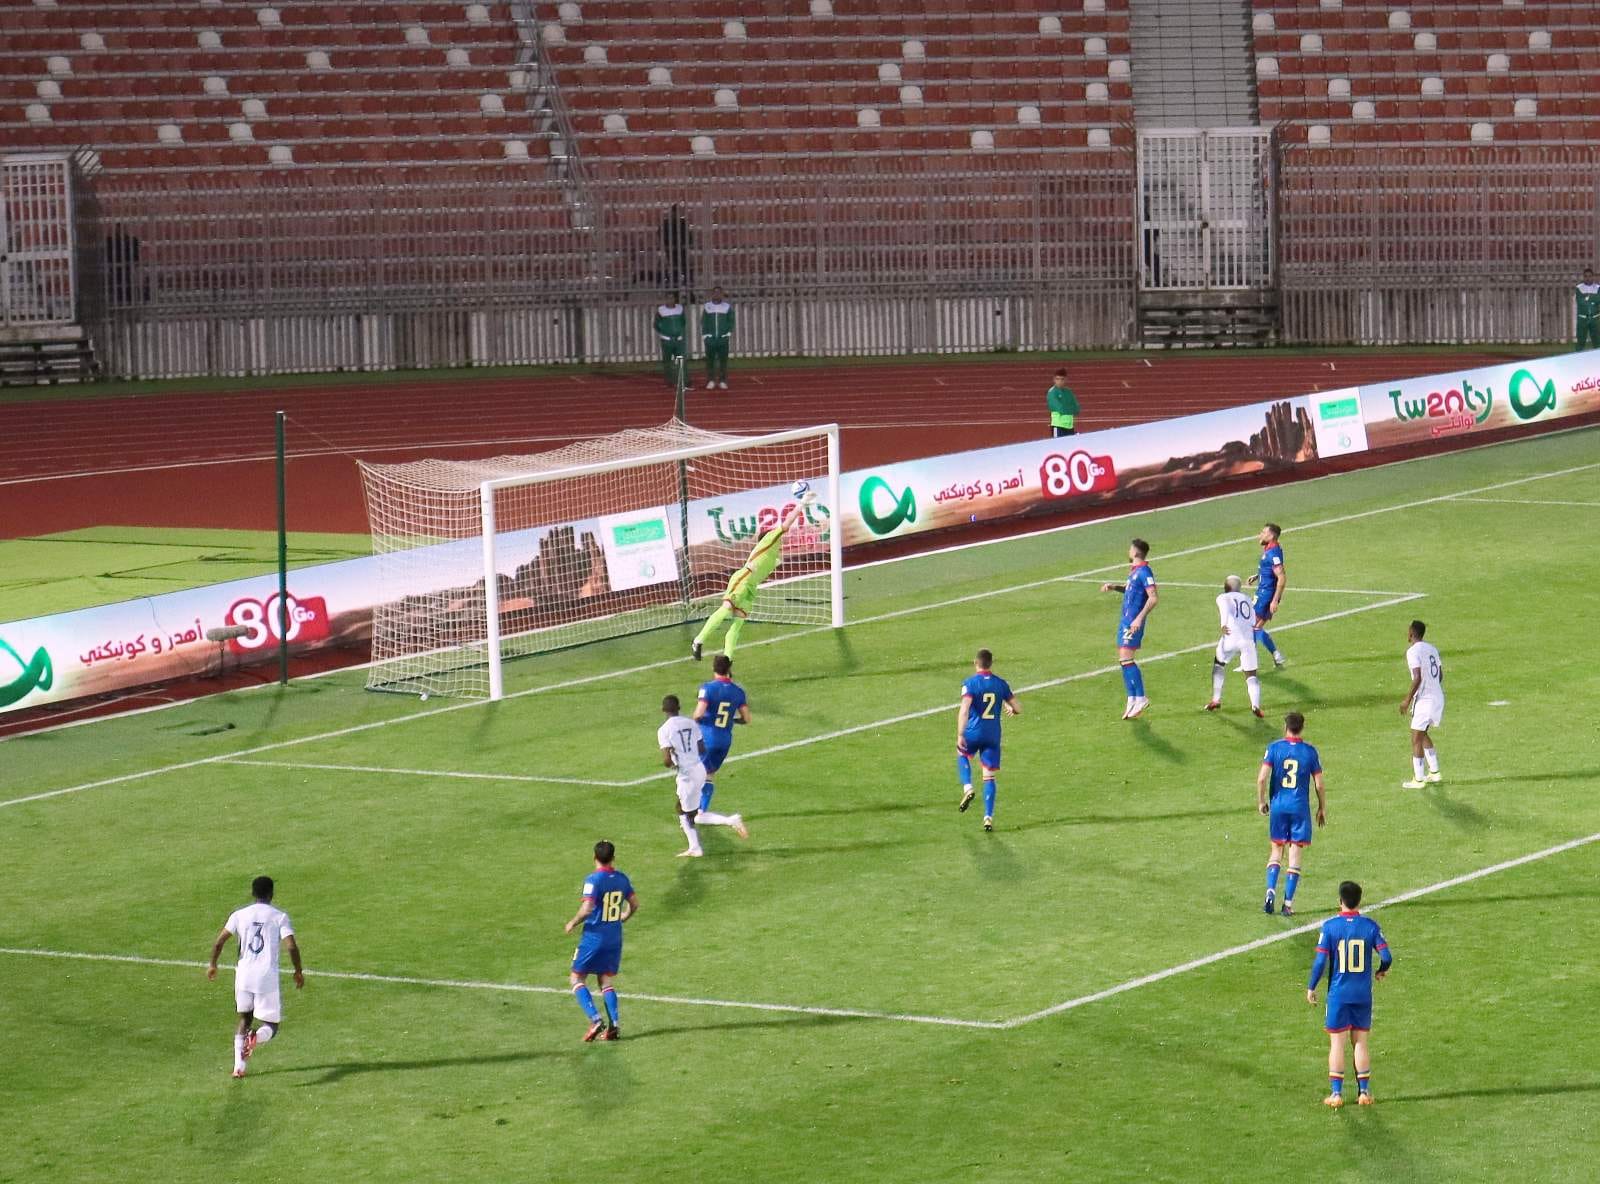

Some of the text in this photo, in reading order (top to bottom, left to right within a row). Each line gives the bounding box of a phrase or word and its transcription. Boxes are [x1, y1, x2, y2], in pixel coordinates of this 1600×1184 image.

[998, 468, 1024, 495] أهدر
[1045, 453, 1095, 497] 80
[985, 482, 994, 497] و
[232, 595, 316, 649] 80 Go
[1233, 598, 1251, 620] 10
[151, 637, 162, 655] و
[168, 617, 203, 651] أهدر
[1429, 654, 1439, 679] 8
[714, 701, 732, 729] 5
[981, 692, 997, 720] 2
[678, 727, 692, 754] 17
[1281, 758, 1299, 790] 3
[601, 890, 624, 923] 18
[247, 921, 266, 956] 3
[1337, 938, 1365, 974] 10
